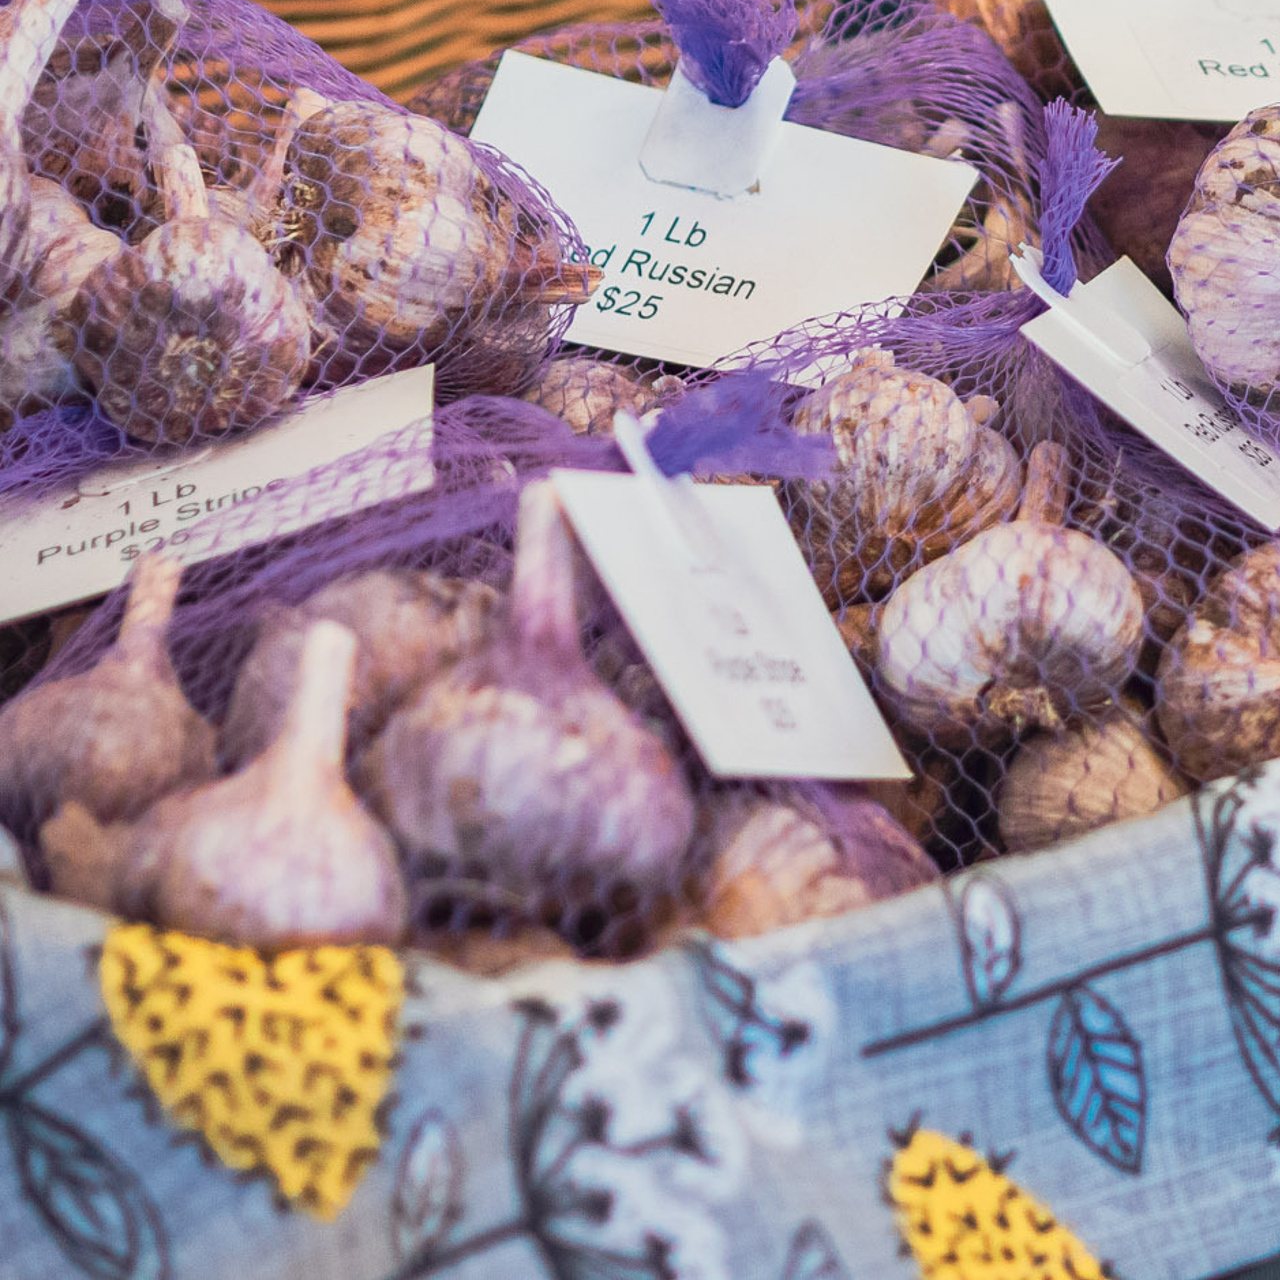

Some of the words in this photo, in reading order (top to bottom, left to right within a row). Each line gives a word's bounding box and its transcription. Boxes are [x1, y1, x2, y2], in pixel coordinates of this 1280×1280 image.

[1259, 38, 1276, 55] 1
[1198, 59, 1270, 78] Red
[641, 211, 655, 236] 1
[664, 216, 707, 248] Lb
[571, 244, 617, 269] ed
[621, 249, 756, 300] Russian
[596, 286, 664, 320] $25
[118, 500, 130, 516] 1
[152, 484, 196, 507] Lb
[37, 519, 160, 565] Purple
[176, 478, 287, 522] Stripe
